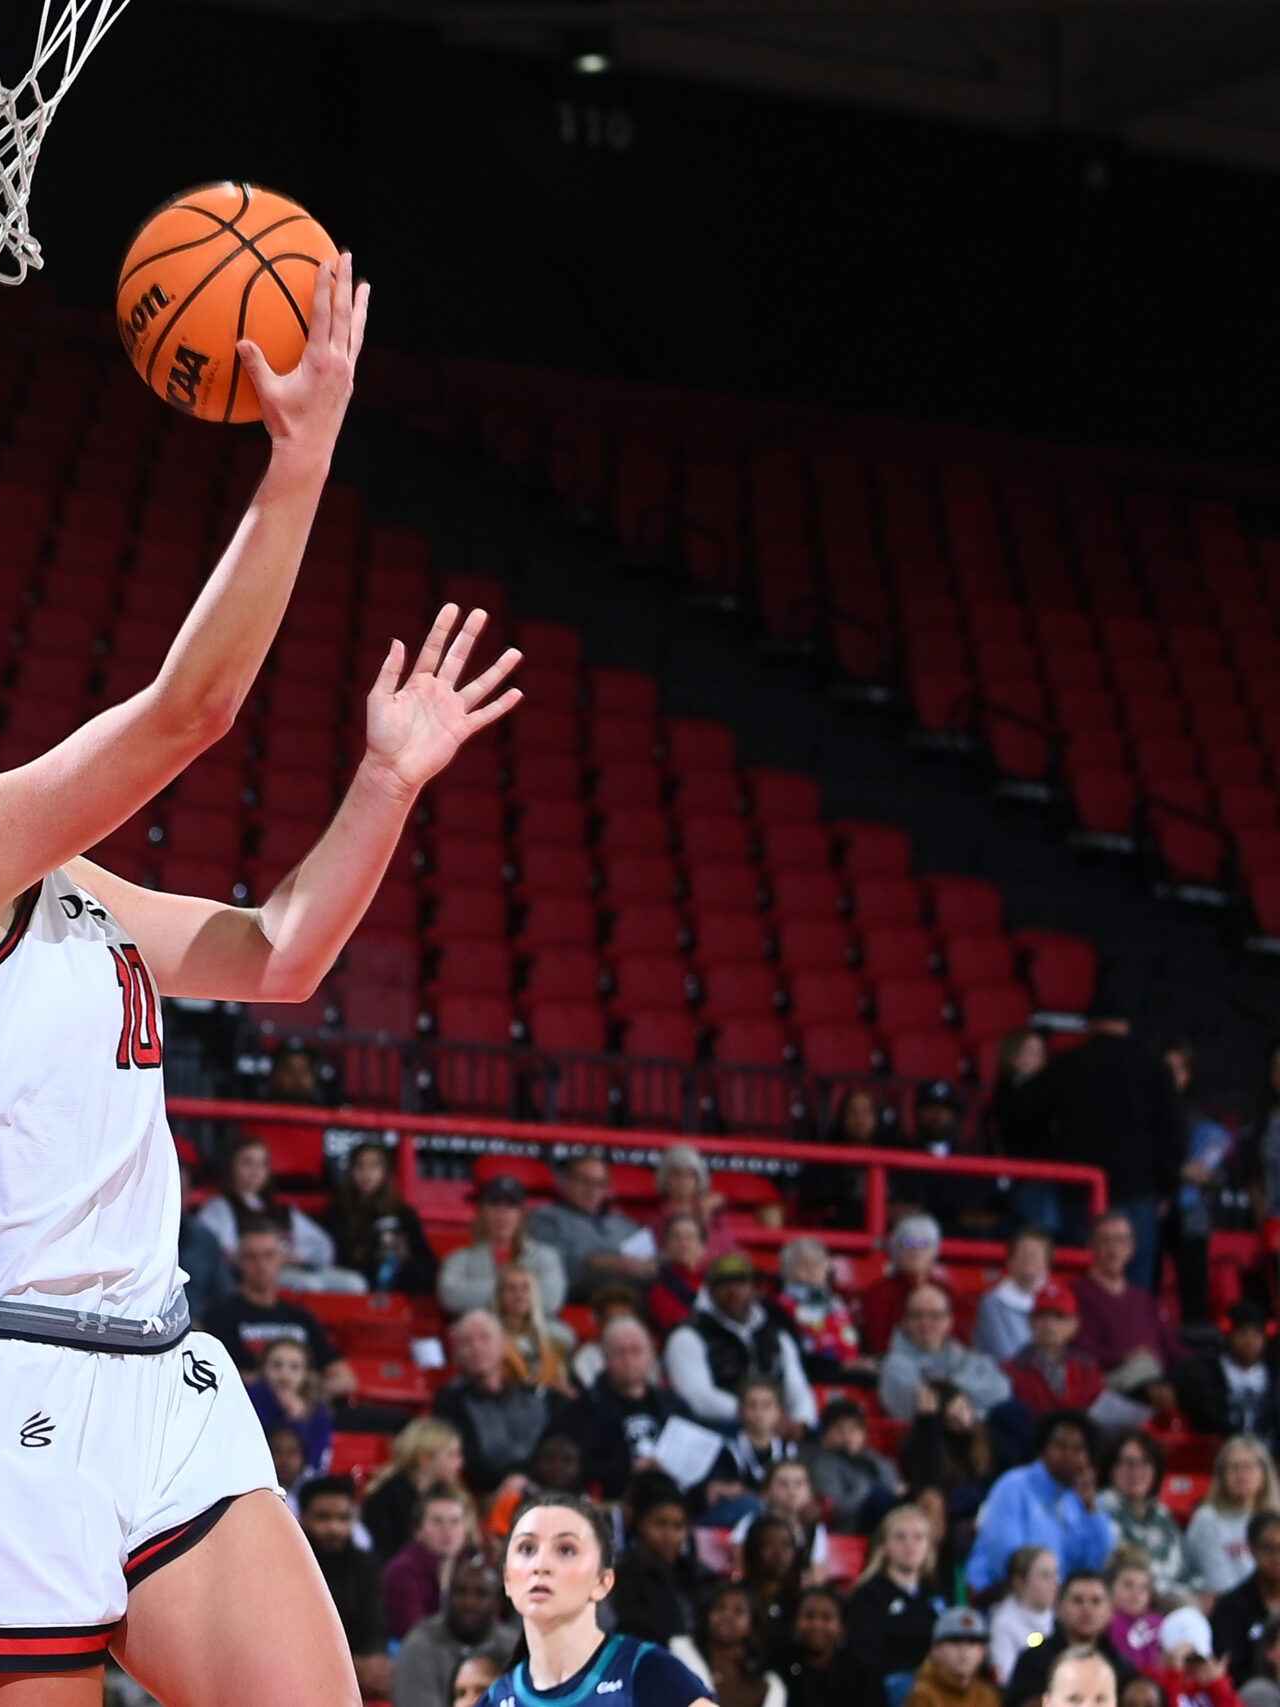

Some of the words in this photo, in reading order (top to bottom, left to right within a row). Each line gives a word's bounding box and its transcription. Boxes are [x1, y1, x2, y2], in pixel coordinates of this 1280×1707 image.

[555, 102, 635, 150] 110
[166, 344, 210, 414] CAA
[107, 943, 161, 1069] 10
